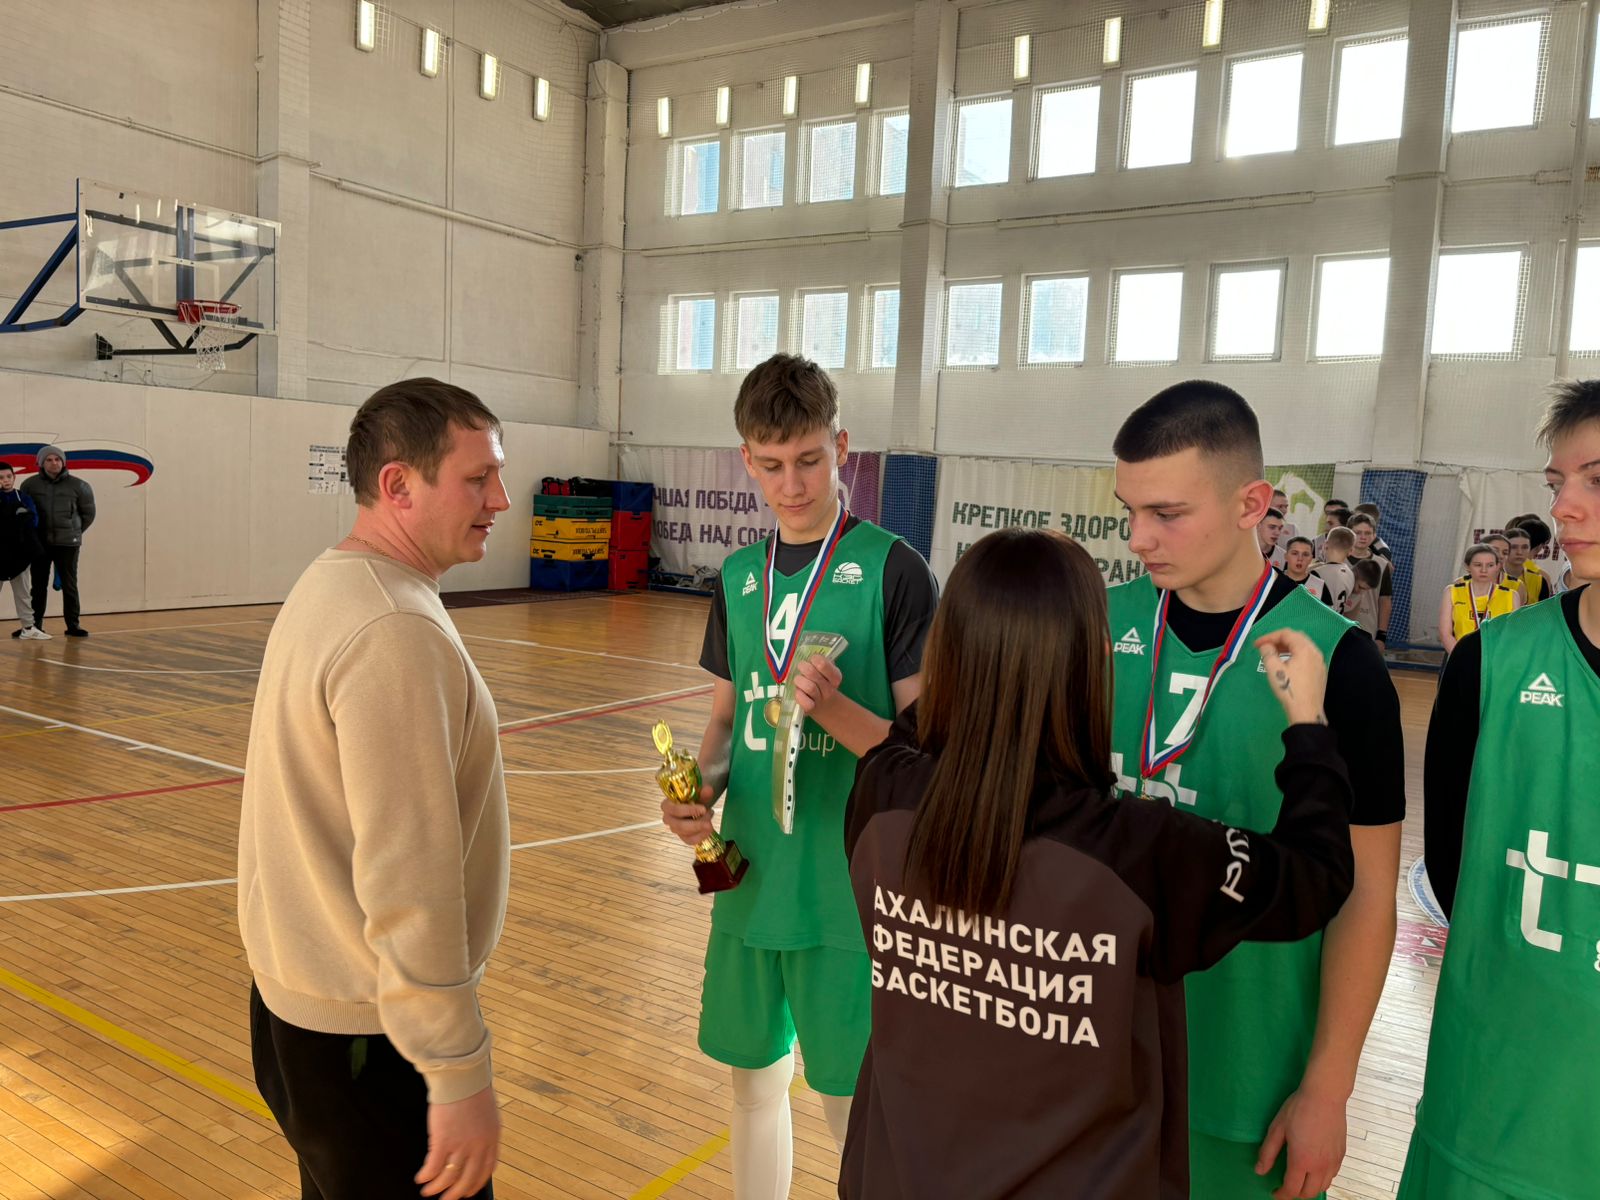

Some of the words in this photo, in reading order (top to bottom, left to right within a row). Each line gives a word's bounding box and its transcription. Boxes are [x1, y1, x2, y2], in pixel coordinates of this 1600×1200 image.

[653, 519, 693, 545] ОБЕДА
[952, 501, 1052, 531] КРЕПКОЕ
[1095, 557, 1149, 583] РАН
[769, 592, 798, 648] 4
[1114, 641, 1147, 656] PEAK
[1164, 672, 1210, 746] 7
[1519, 690, 1565, 708] PEAK
[873, 885, 1117, 966] АХАЛИНСКАЯ
[872, 923, 1094, 1005] ФЕДЕРАЦИЯ
[871, 957, 1101, 1049] БАСКЕТБОЛА
